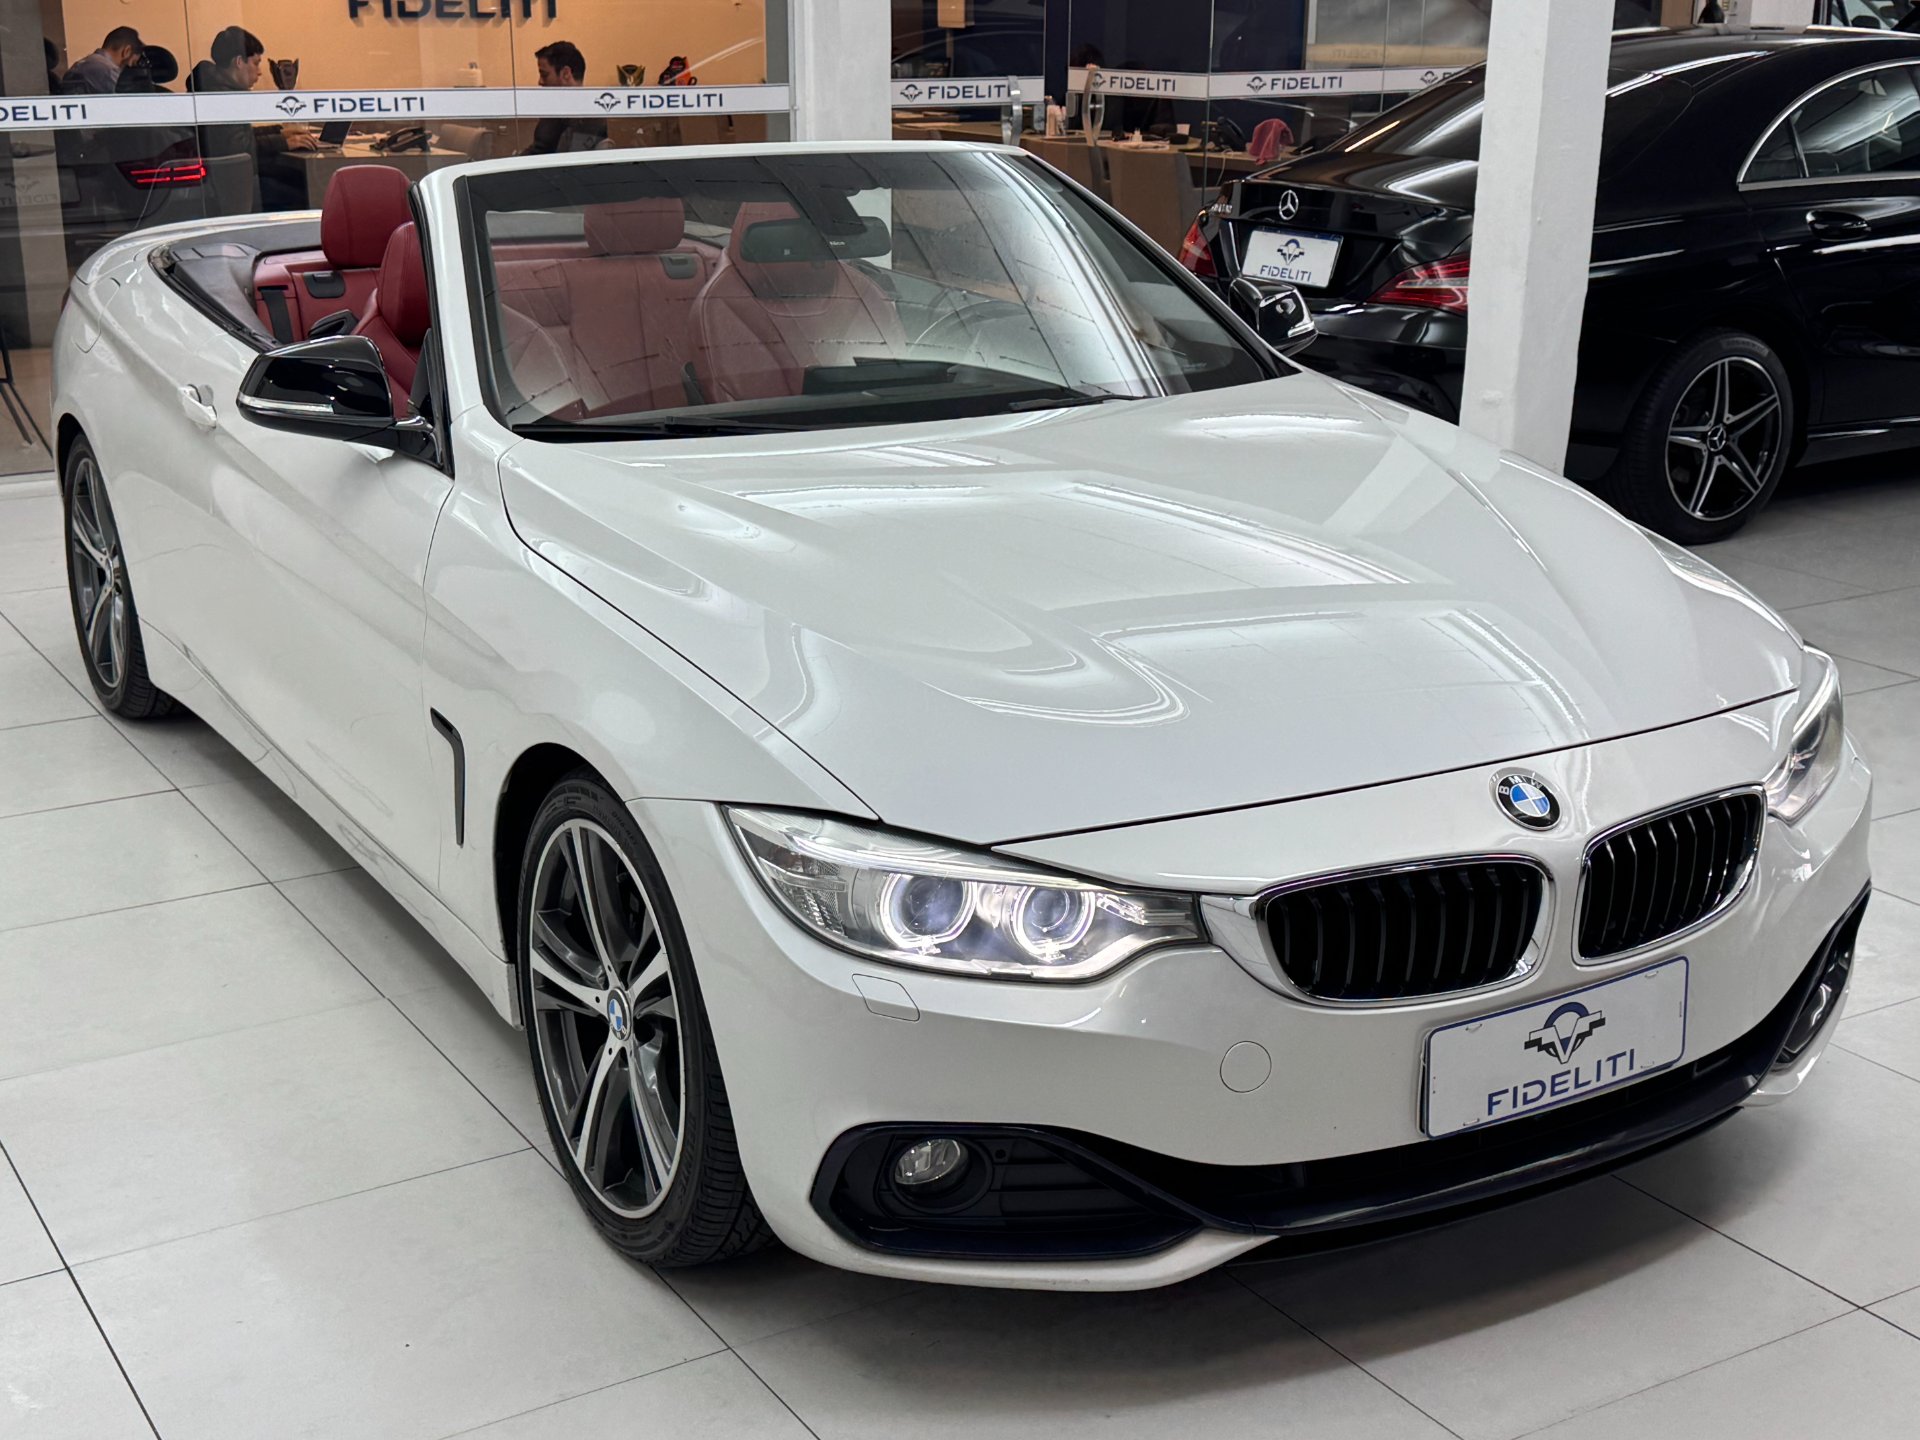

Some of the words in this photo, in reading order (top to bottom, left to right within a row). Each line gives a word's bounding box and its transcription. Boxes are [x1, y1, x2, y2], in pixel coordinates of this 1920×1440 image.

[1110, 76, 1176, 92] FIDELITI
[1270, 76, 1343, 90] FIDELITI
[928, 84, 1010, 99] FIDELITI
[313, 97, 425, 113] FIDELITI
[626, 93, 723, 109] FIDELITI
[1260, 264, 1312, 282] FIDELITI
[1487, 1048, 1635, 1116] FIDELITI
